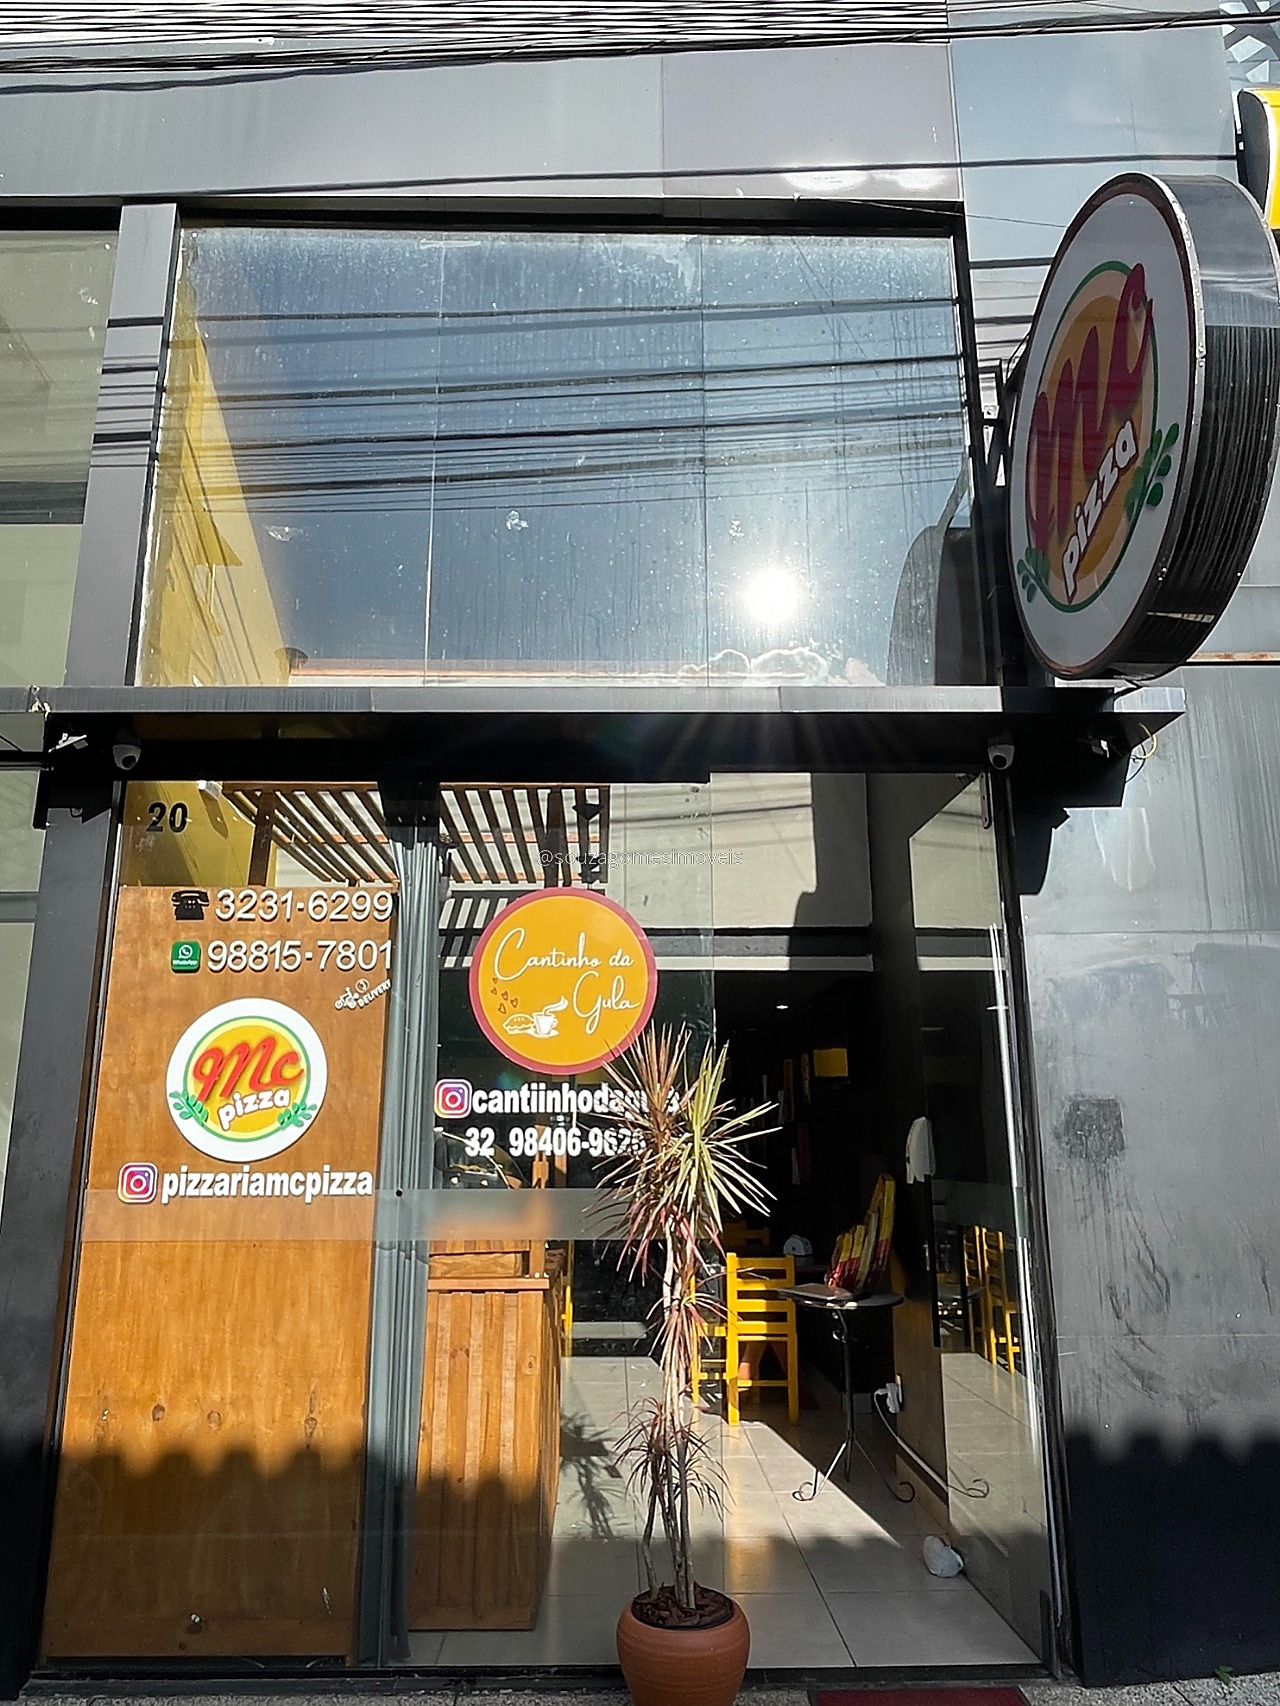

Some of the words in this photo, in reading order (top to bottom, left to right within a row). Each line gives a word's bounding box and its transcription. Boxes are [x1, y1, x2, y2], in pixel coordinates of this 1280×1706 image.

[1061, 420, 1139, 605] pizza
[146, 801, 188, 833] 20
[215, 888, 393, 922] 3231-6299
[207, 939, 392, 972] 98815-7801
[493, 926, 602, 981] Cantinho
[608, 947, 635, 968] da
[357, 978, 391, 1008] DELIVERY
[572, 970, 641, 1035] Gula
[217, 1088, 290, 1131] pizza
[464, 1126, 496, 1157] 32
[161, 1164, 373, 1199] pizzariamcpizza
